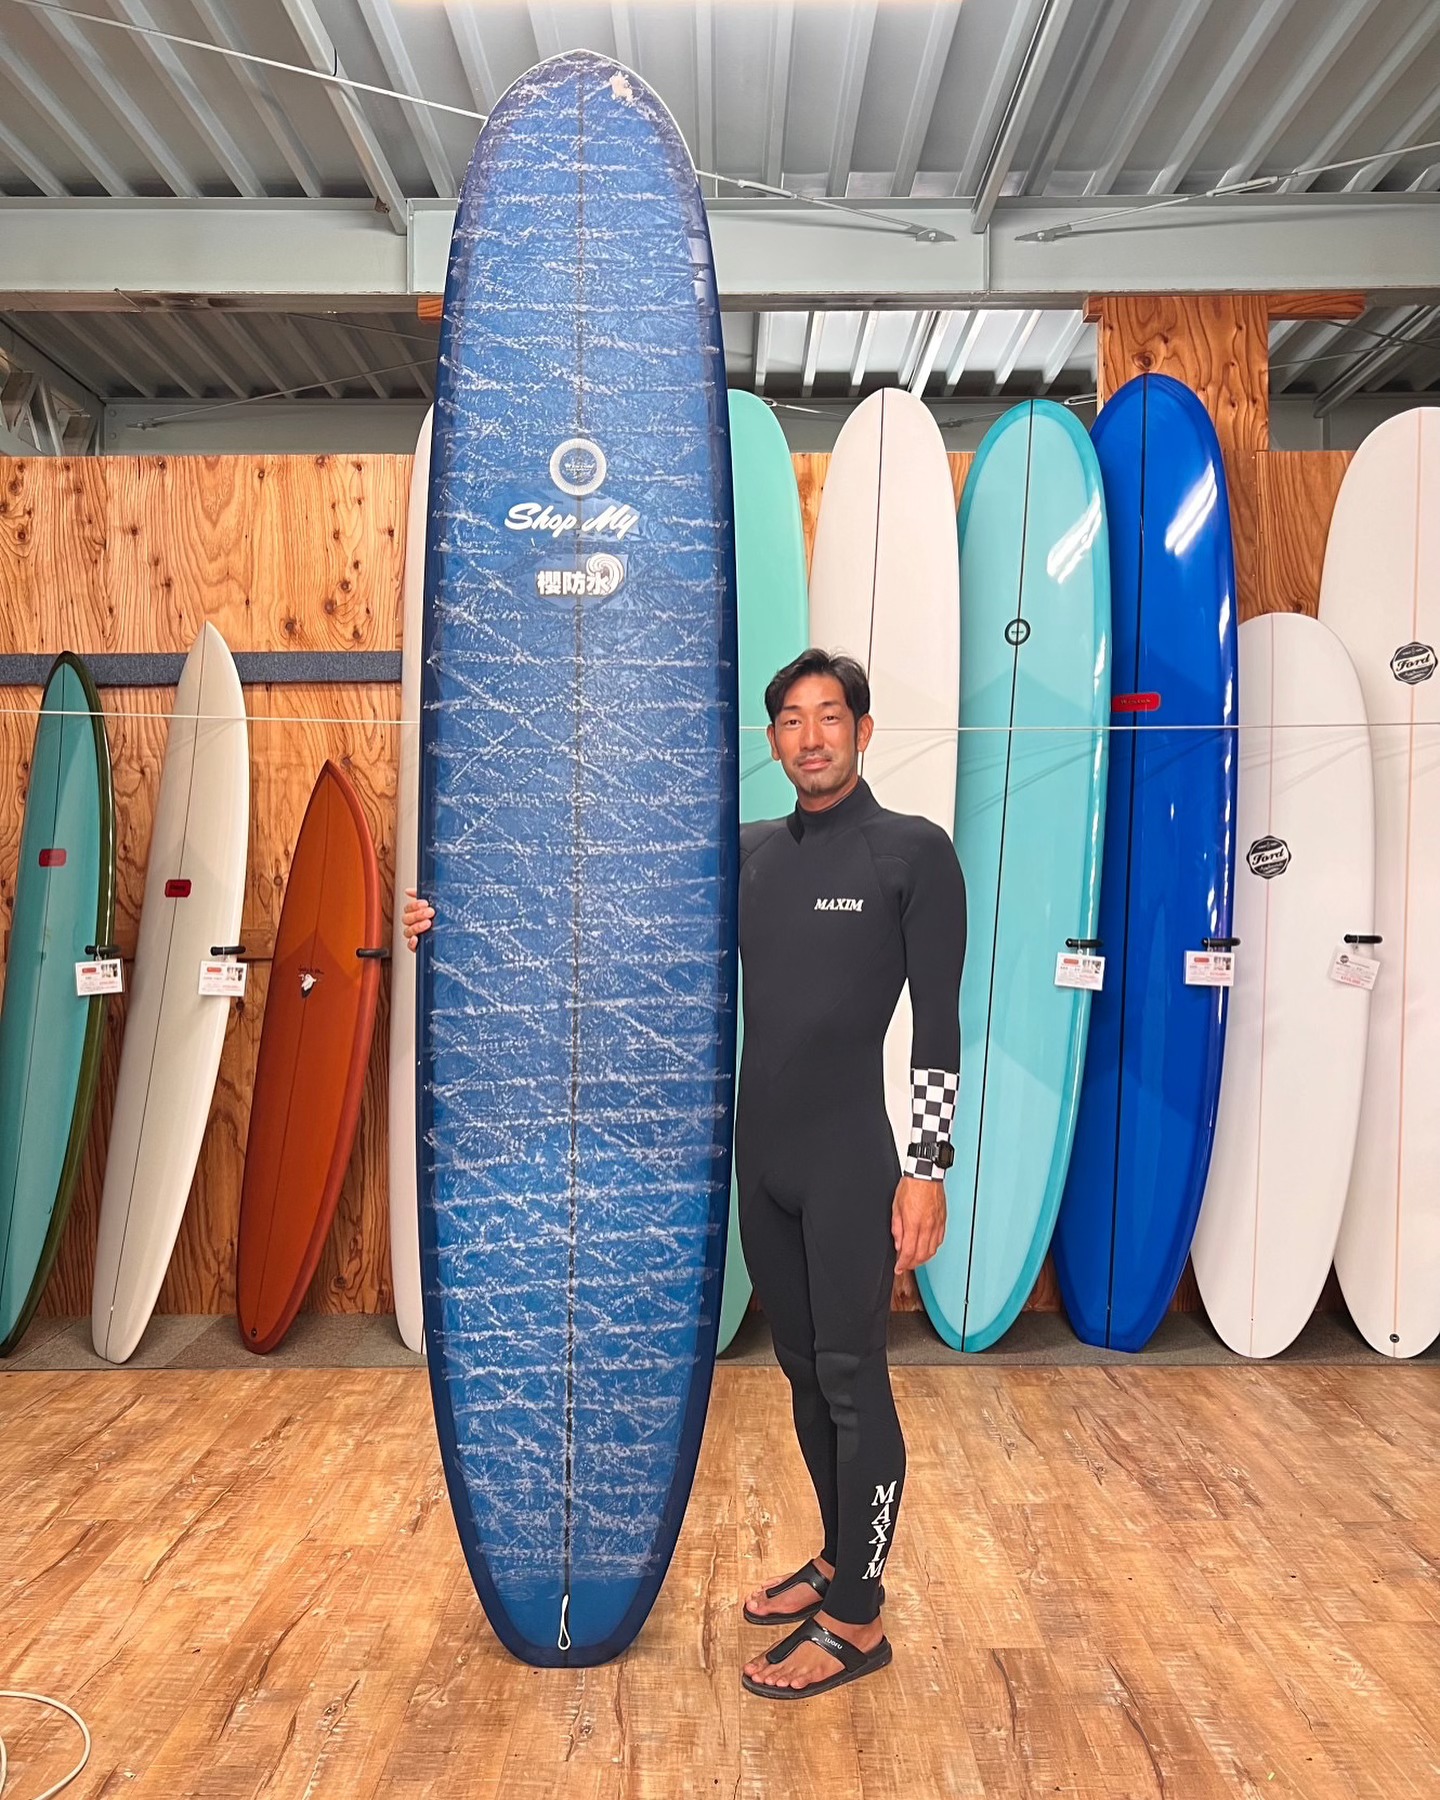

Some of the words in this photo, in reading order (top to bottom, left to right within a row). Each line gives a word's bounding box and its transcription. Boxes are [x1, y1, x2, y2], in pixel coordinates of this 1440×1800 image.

[504, 502, 577, 538] Shop
[581, 504, 639, 540] My
[1396, 653, 1431, 672] Ford
[1252, 847, 1285, 866] Ford
[814, 898, 864, 912] MAXIM
[862, 1480, 898, 1580] MAXIM
